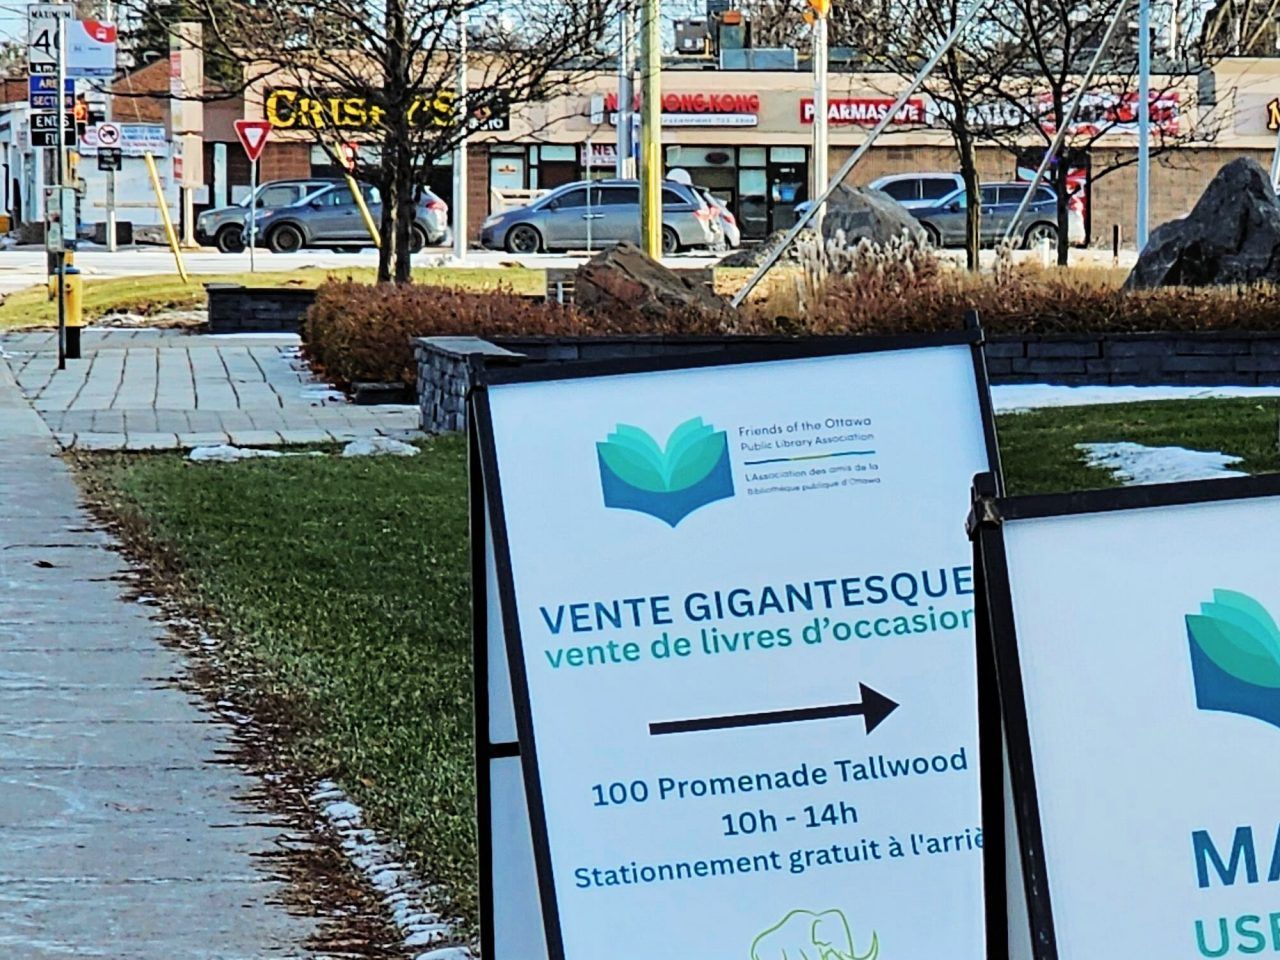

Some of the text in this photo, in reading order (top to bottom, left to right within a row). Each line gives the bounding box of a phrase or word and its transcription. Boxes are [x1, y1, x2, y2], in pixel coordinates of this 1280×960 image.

[39, 79, 58, 88] ARE
[661, 93, 760, 112] ONG-KONG
[804, 103, 920, 120] PARMASVE
[592, 145, 618, 156] NE
[739, 417, 872, 437] Friends of the Ottawa
[741, 433, 875, 452] Public Library Association
[809, 467, 827, 477] des
[855, 464, 867, 472] de
[869, 463, 879, 471] la
[539, 566, 975, 635] VENTE GIGANTESQUE
[544, 638, 641, 669] vente
[651, 632, 692, 660] de
[701, 622, 793, 655] livres
[591, 747, 969, 807] 100 Promenade Tallwood
[721, 809, 777, 837] 10h
[803, 801, 858, 829] 14h
[573, 827, 983, 889] Stationnement gratuit à l'arriè
